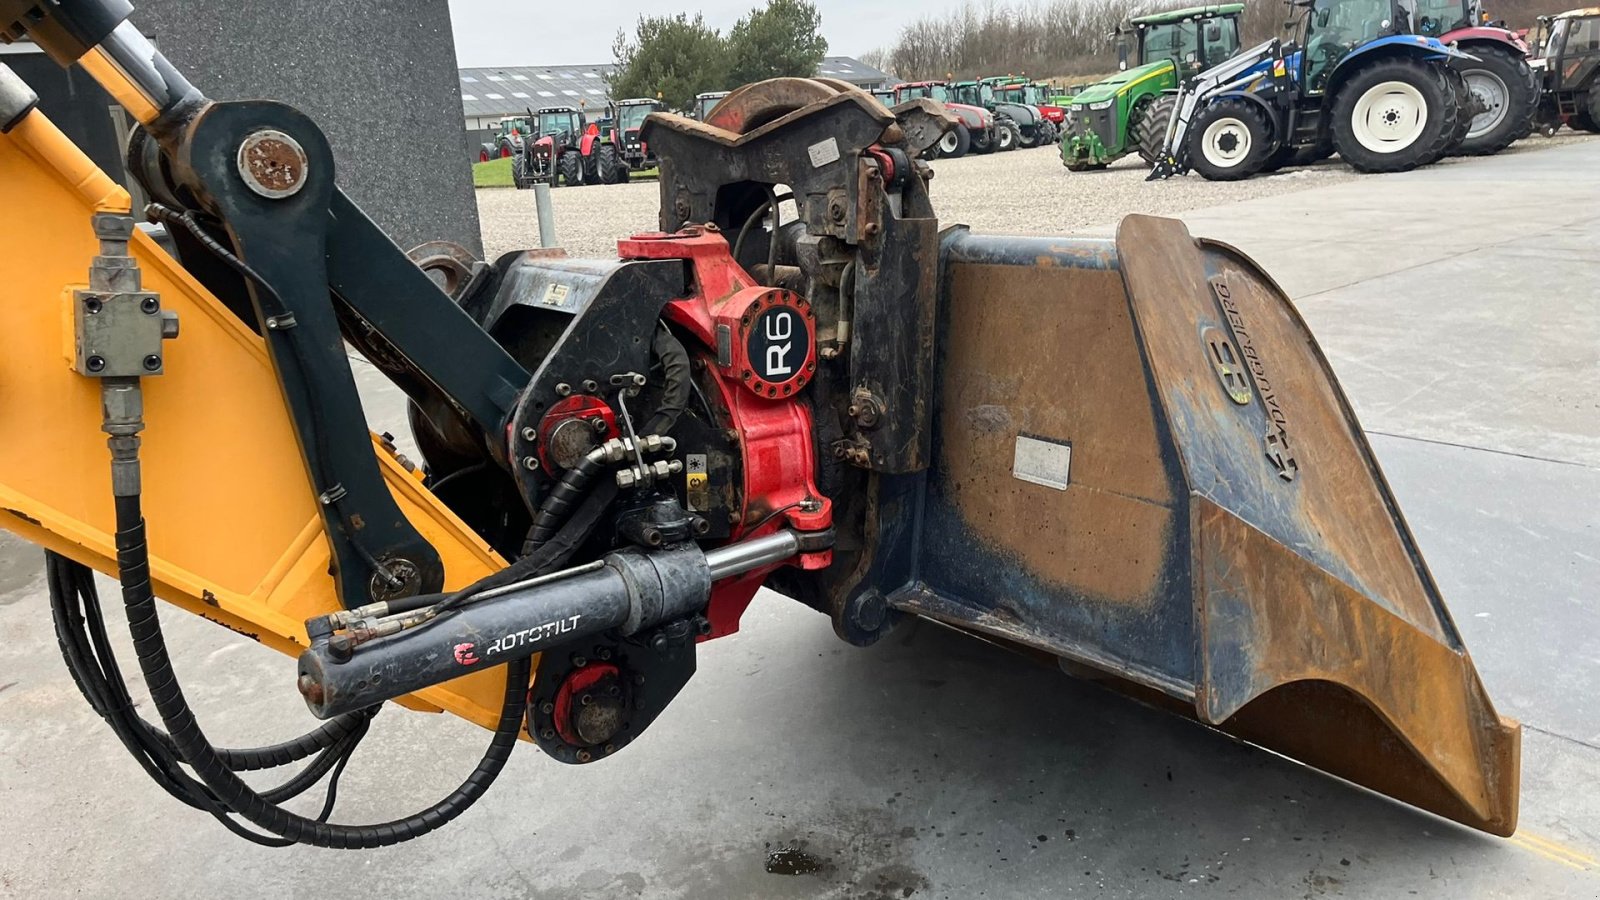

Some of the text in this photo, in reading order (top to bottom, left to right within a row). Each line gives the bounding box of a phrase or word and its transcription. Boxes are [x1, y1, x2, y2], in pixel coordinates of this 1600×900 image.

[766, 312, 791, 375] R6
[1216, 282, 1286, 426] DAUGBJERG
[487, 615, 580, 655] ROTOTILT
